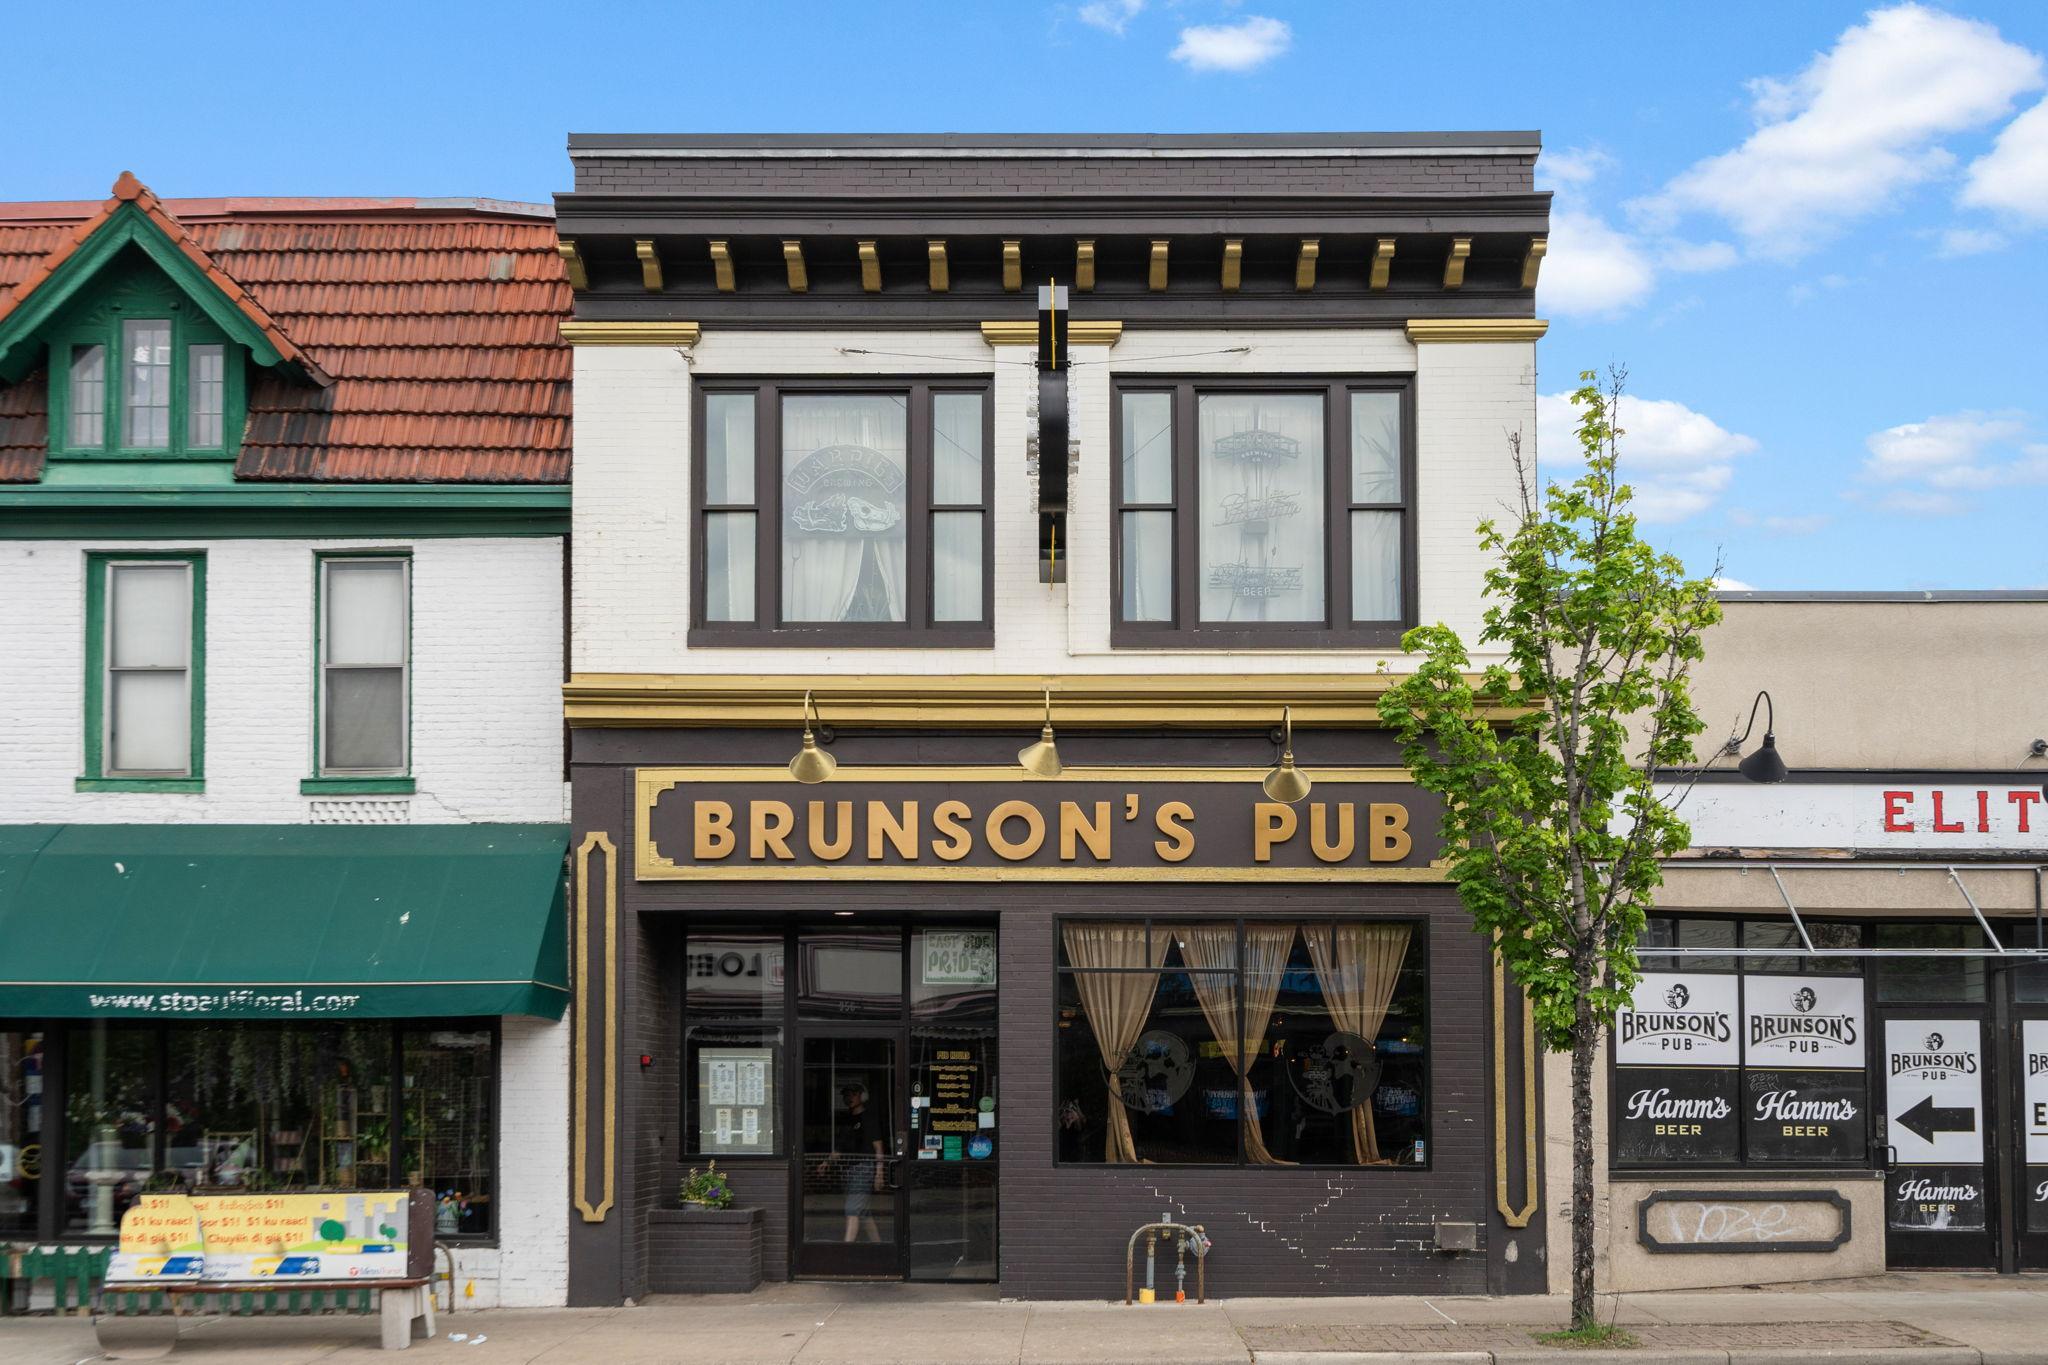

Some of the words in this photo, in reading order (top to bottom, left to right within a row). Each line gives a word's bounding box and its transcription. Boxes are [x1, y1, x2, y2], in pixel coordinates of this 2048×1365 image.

[692, 793, 1195, 863] BRUNSON'S
[1255, 802, 1412, 862] PUB
[928, 935, 959, 948] EAST
[928, 950, 979, 974] PRIDE
[1622, 1011, 1732, 1045] BRUNSON'S
[1750, 1013, 1857, 1047] BRUNSON'S
[1661, 1038, 1693, 1051] PUB
[1789, 1040, 1819, 1053] PUB
[1891, 1051, 1977, 1077] BRUNSON'S
[1922, 1071, 1947, 1080] PUB
[1625, 1088, 1732, 1120] Hamm's
[1754, 1089, 1857, 1121] Hamm's
[1655, 1124, 1702, 1135] BEER
[1782, 1125, 1829, 1137] BEER
[1897, 1178, 1978, 1202] Hamm's
[132, 1216, 145, 1226] $1
[221, 1217, 240, 1227] $1!
[247, 1216, 261, 1226] $1
